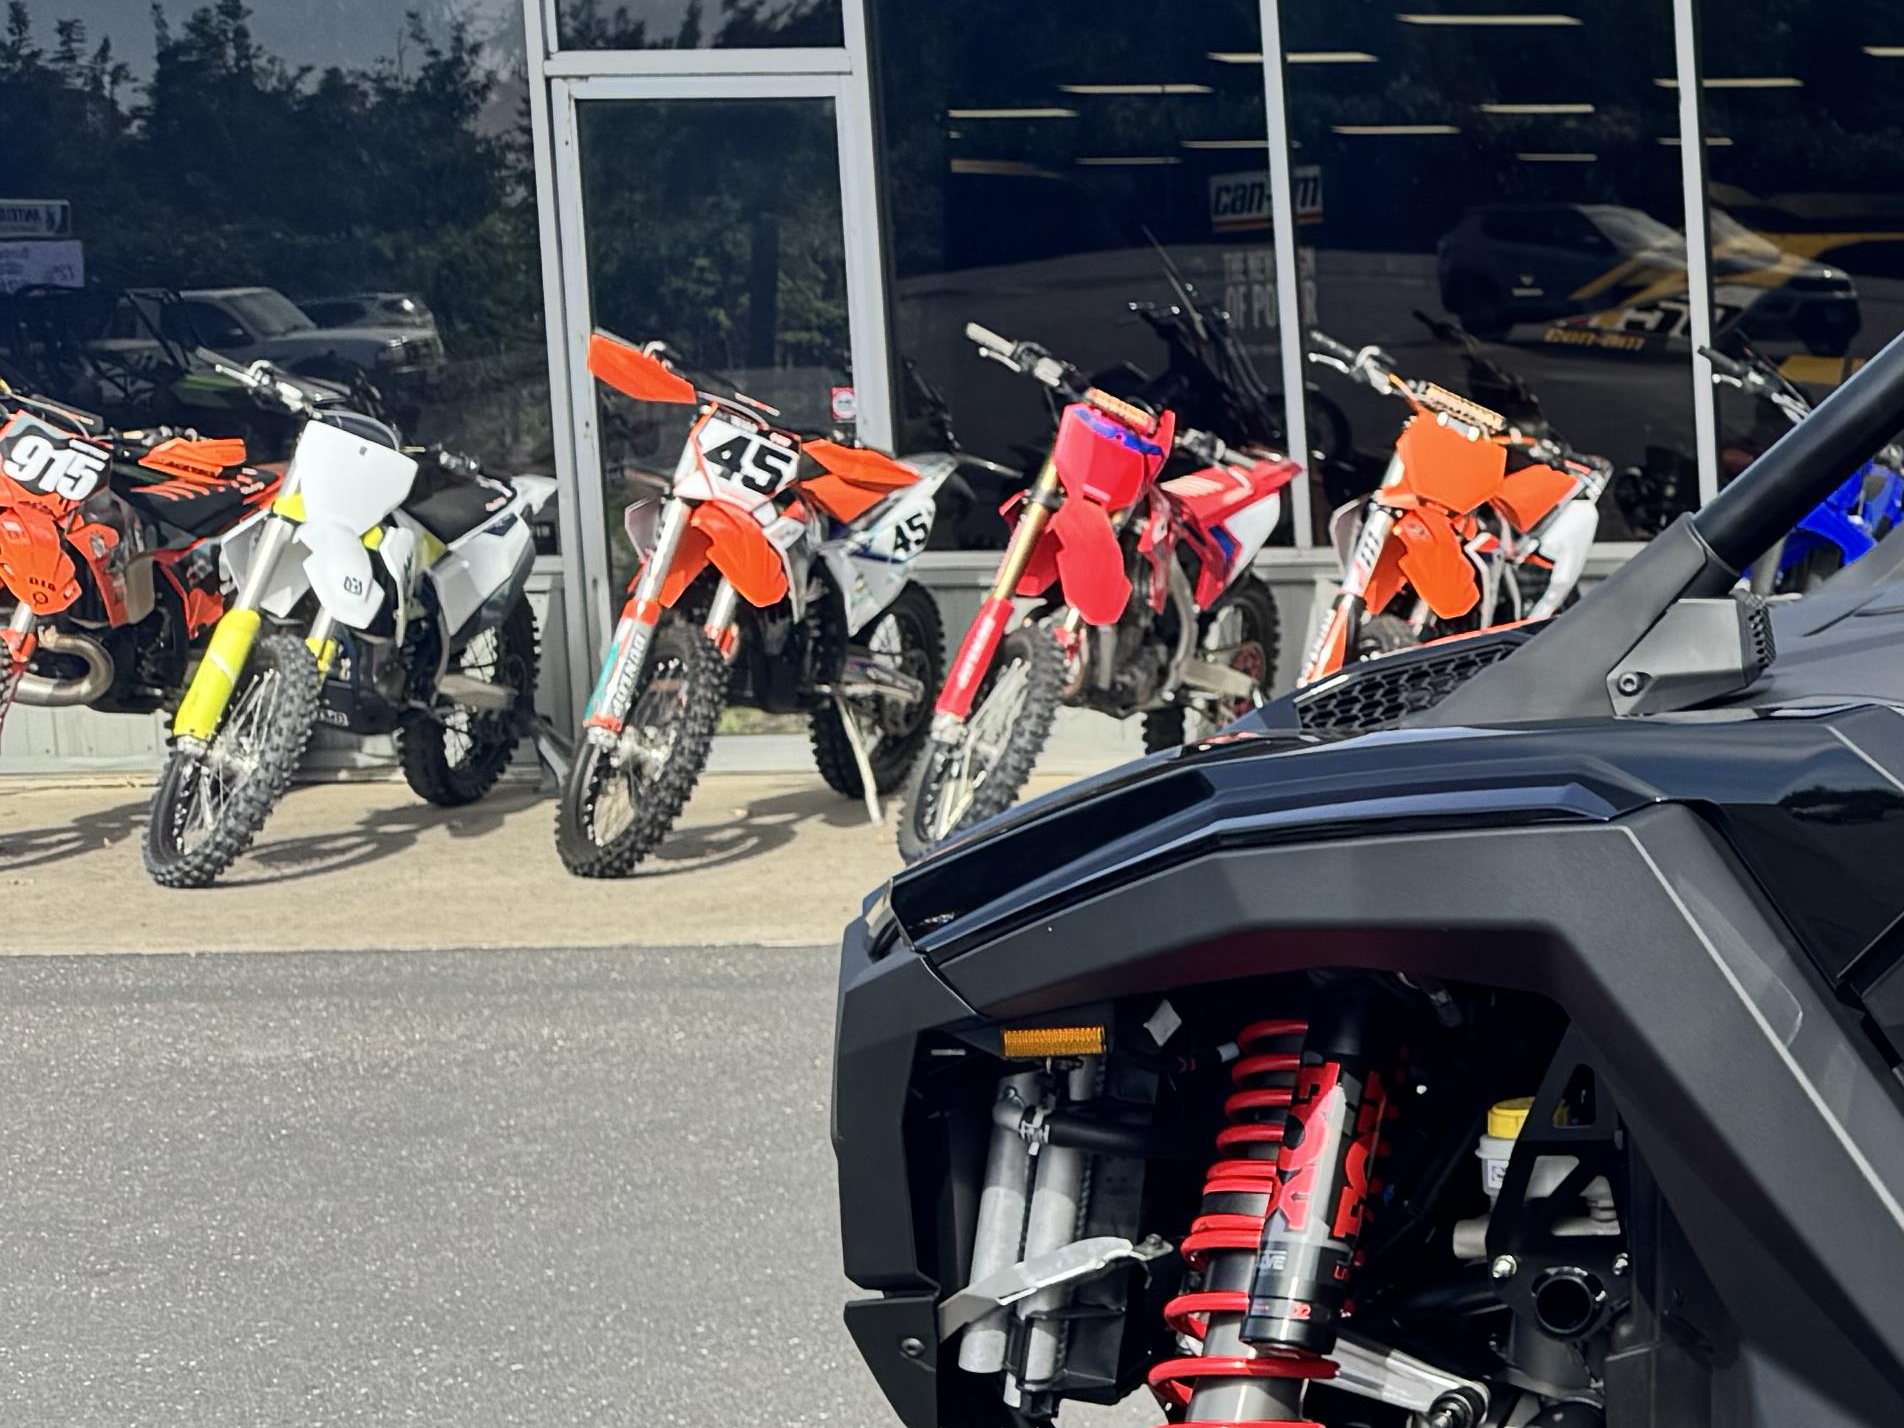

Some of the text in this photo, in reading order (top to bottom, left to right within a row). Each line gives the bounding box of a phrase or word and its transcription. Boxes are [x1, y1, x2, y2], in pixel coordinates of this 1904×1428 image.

[3, 434, 106, 501] 915
[703, 434, 794, 496] 45
[893, 513, 929, 560] 45
